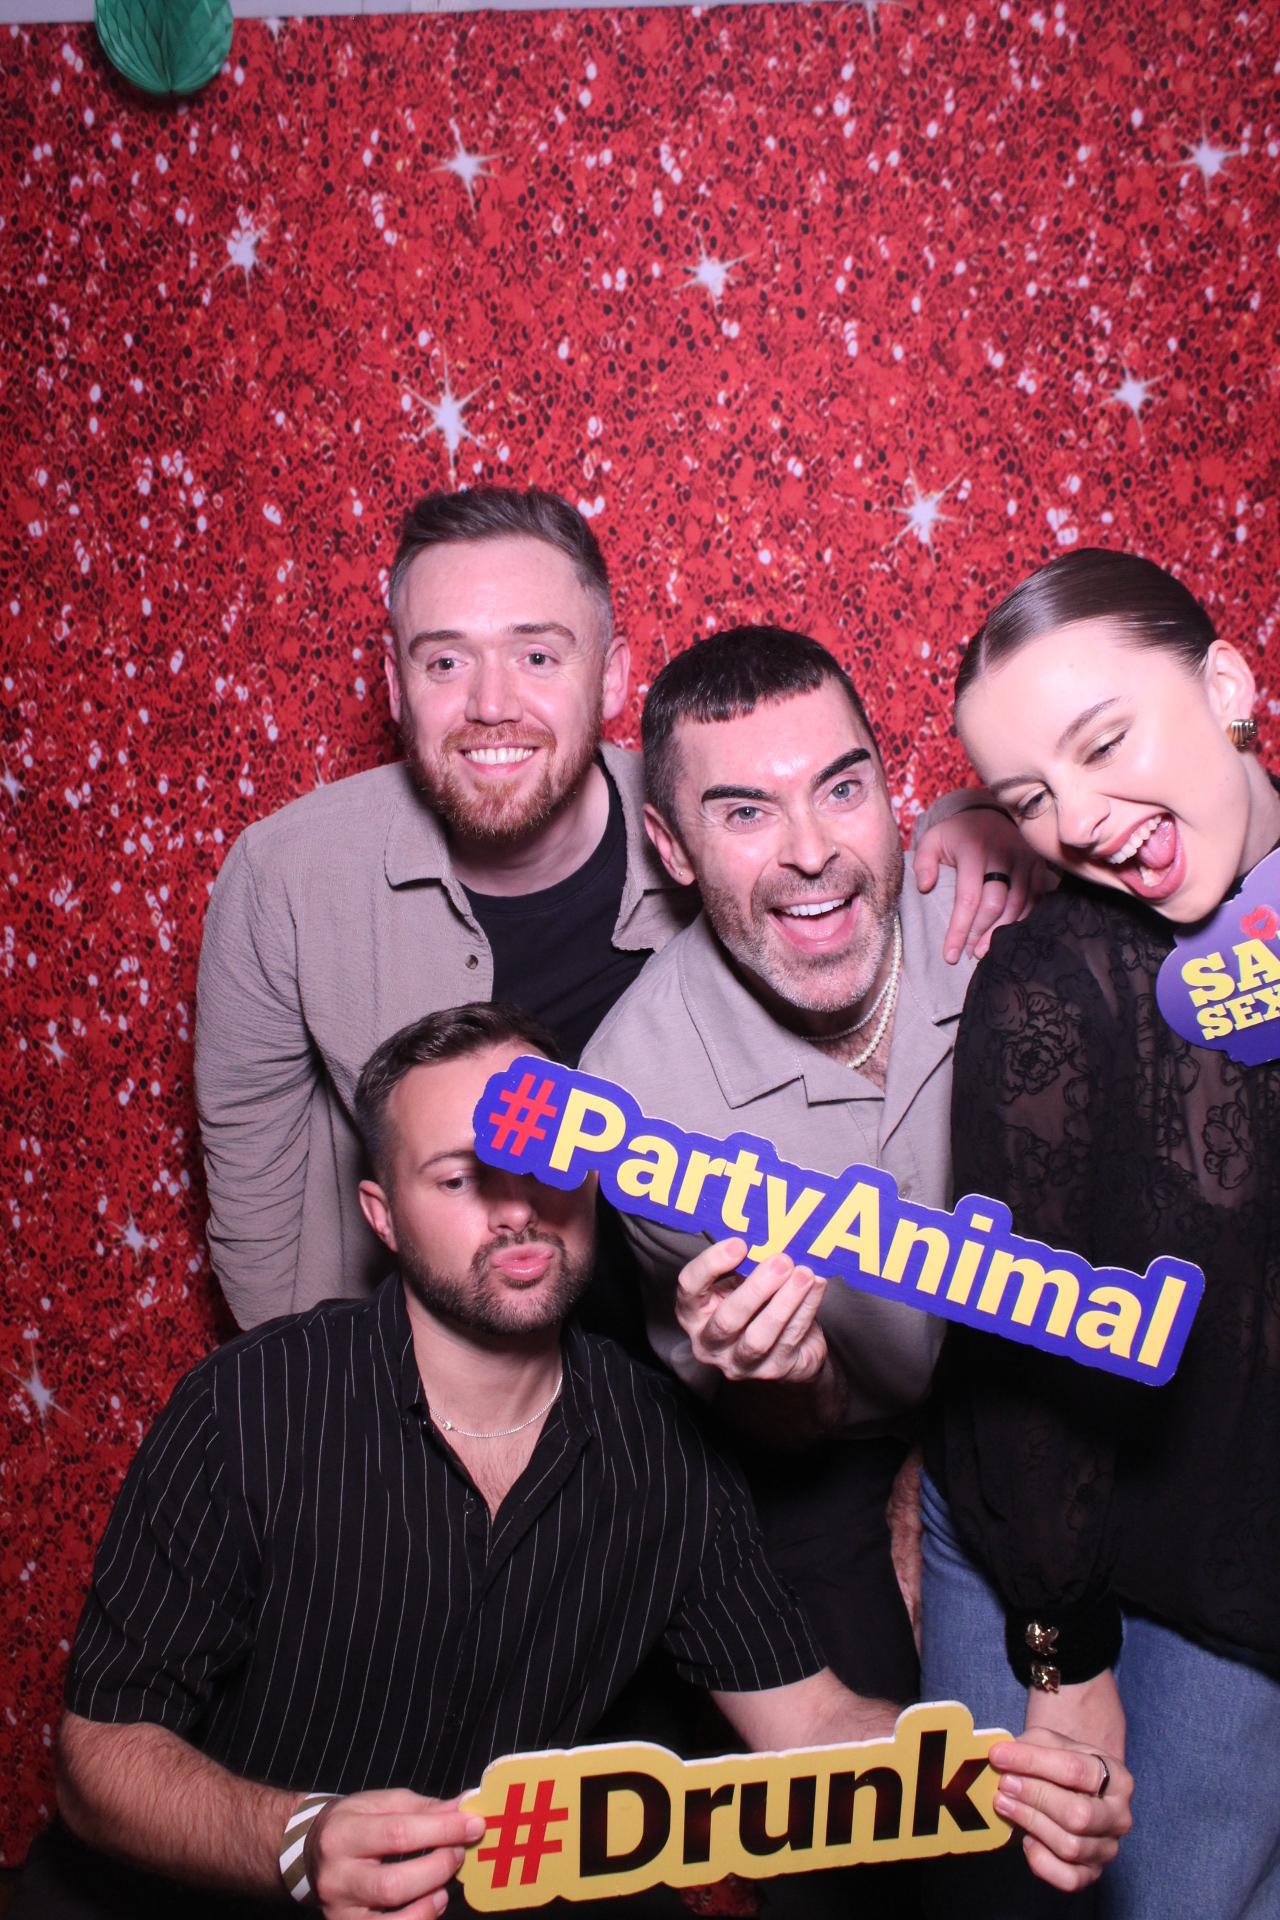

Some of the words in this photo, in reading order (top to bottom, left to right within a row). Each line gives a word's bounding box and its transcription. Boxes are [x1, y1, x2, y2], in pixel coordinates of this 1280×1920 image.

[1181, 931, 1280, 1007] SA
[488, 1073, 1187, 1367] #PartyAnimal
[477, 1729, 990, 1888] #Drunk
